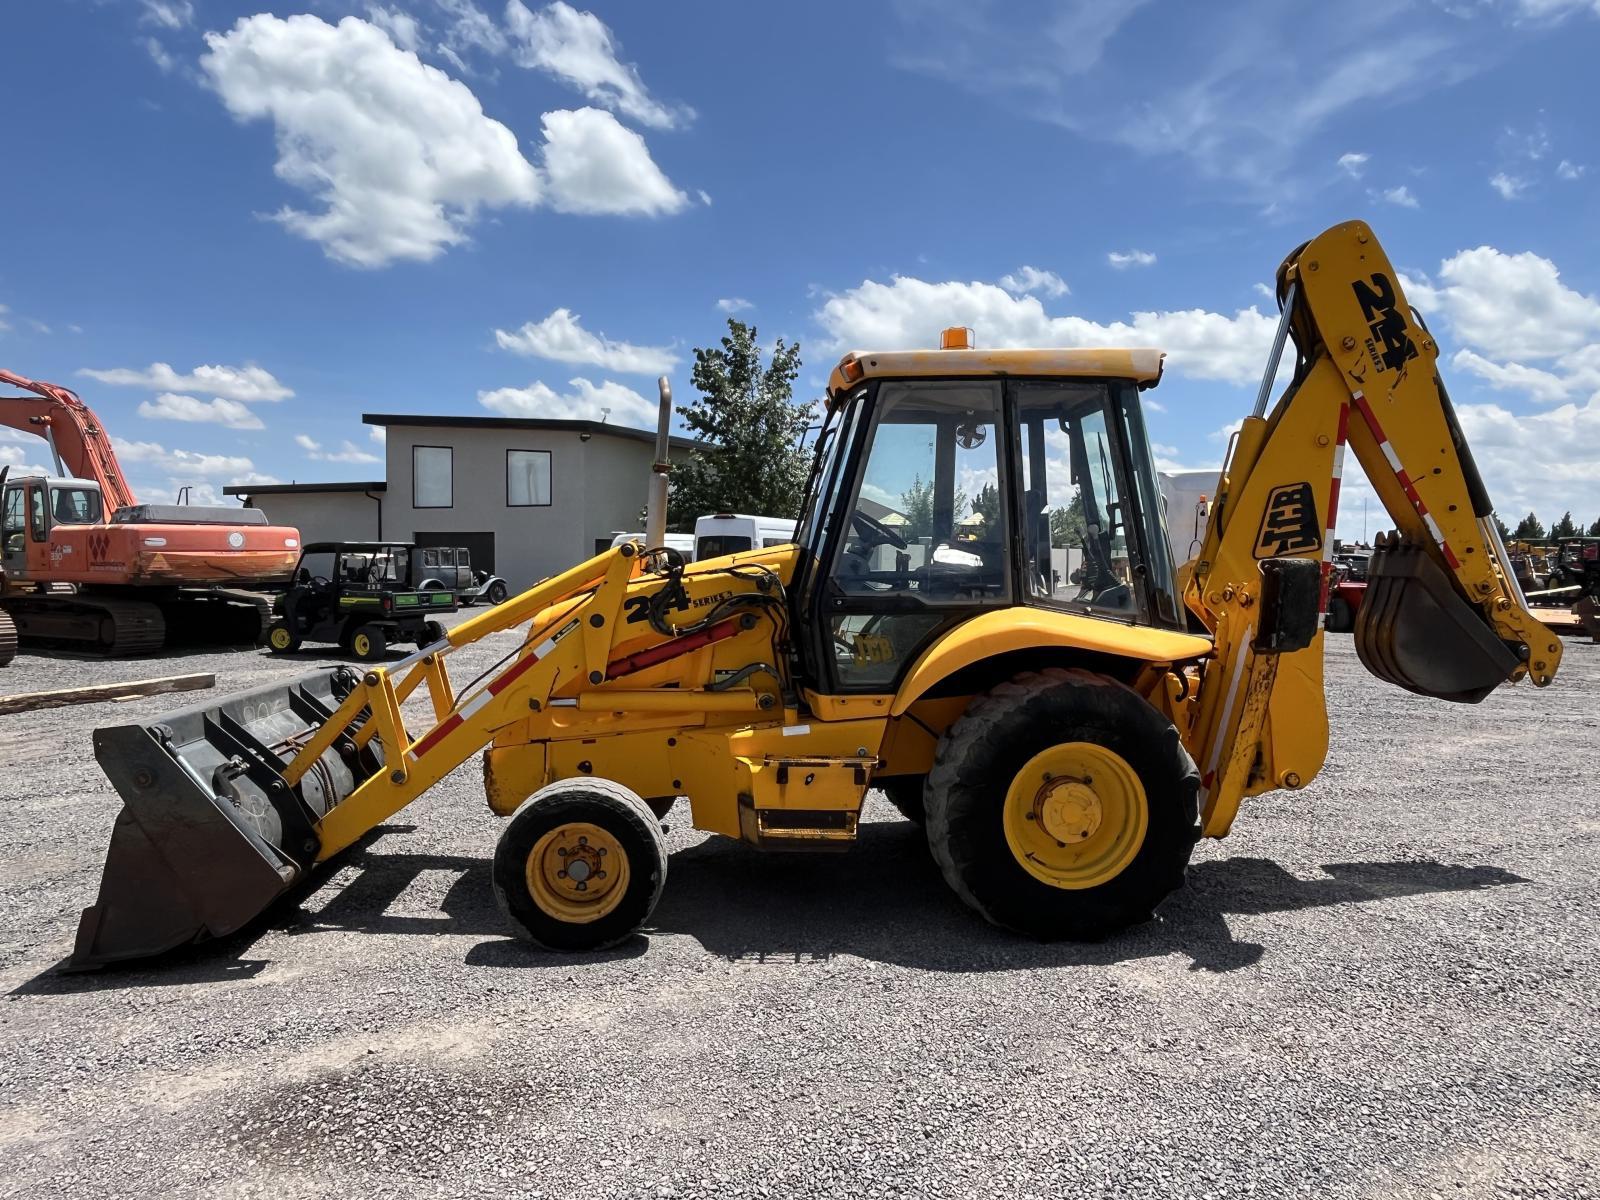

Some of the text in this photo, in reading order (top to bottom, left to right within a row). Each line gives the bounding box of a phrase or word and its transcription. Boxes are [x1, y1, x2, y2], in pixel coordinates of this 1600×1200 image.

[1352, 273, 1419, 371] 214
[1364, 338, 1382, 367] SERIES
[1260, 485, 1318, 555] JCB
[624, 586, 691, 624] 24
[693, 593, 725, 608] SERIES
[852, 635, 893, 666] JCB
